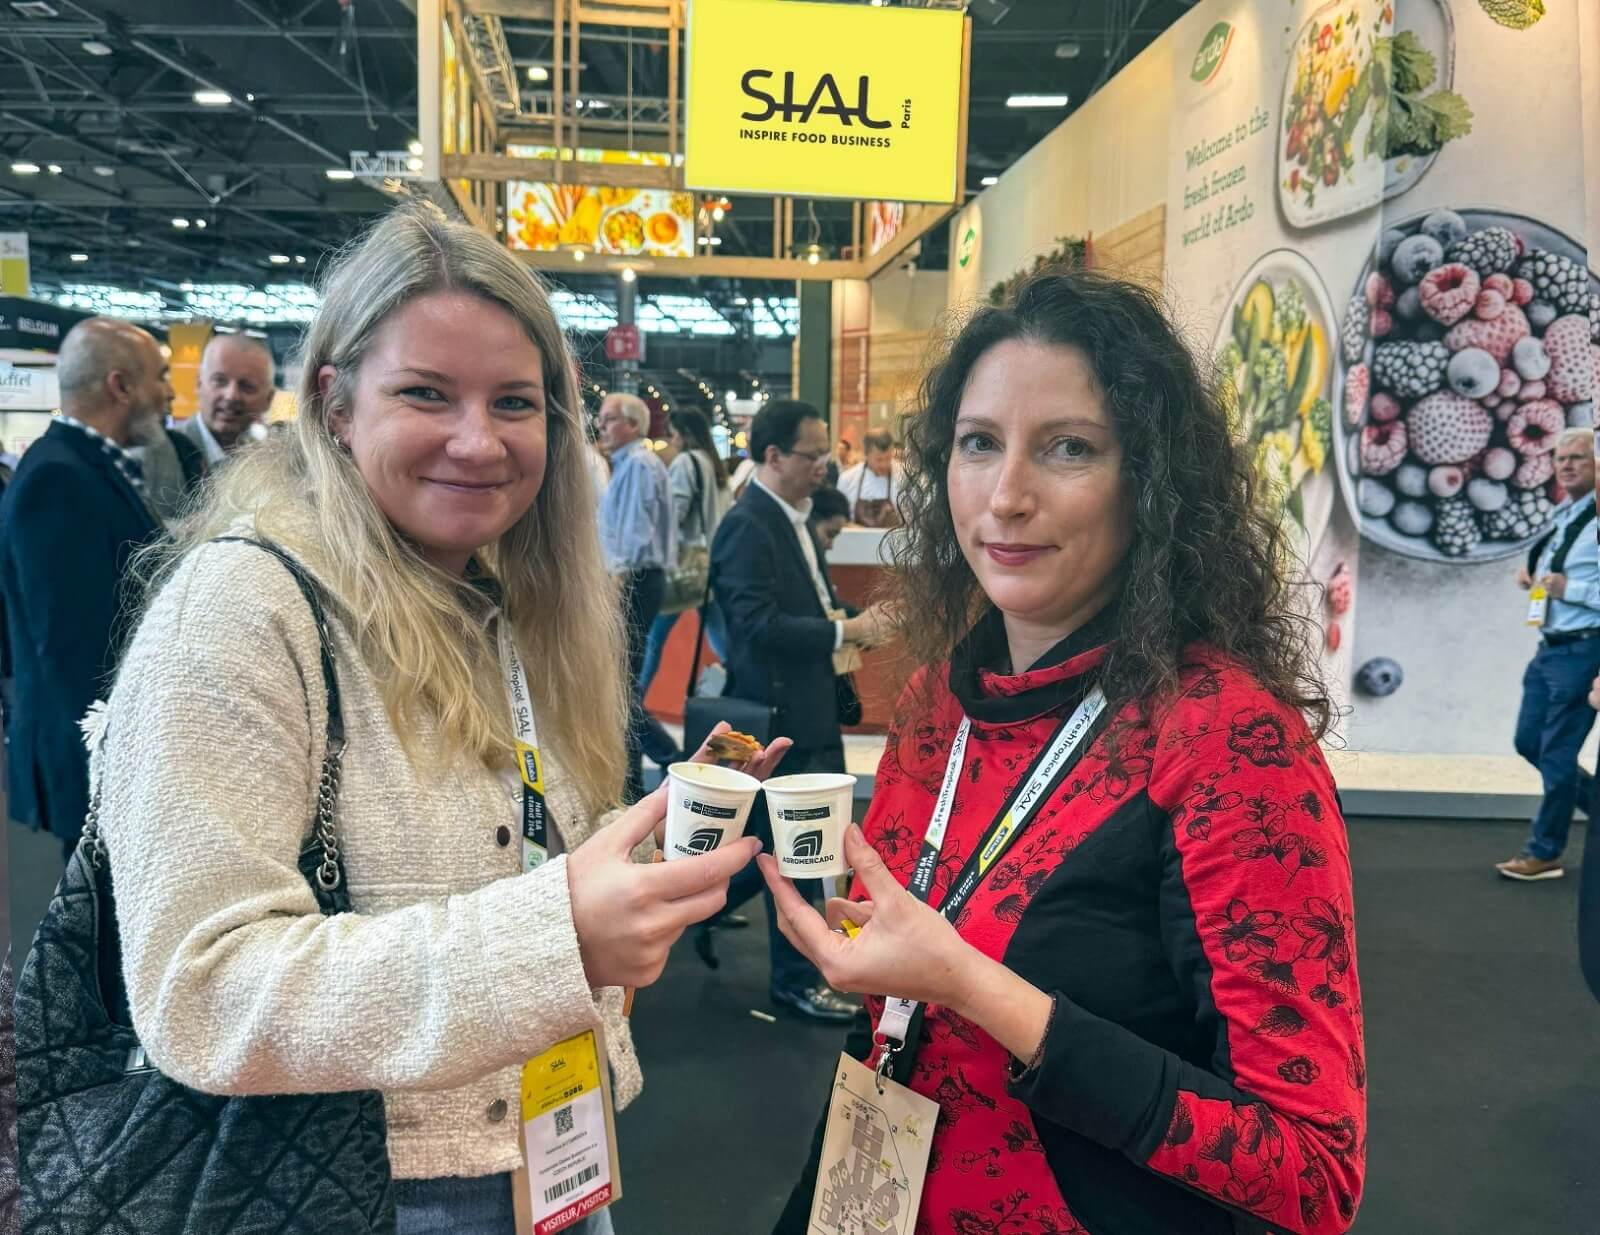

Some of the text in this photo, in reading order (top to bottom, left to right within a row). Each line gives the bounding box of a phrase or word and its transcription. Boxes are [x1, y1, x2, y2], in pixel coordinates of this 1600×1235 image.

[740, 69, 892, 129] SIAL
[901, 98, 912, 128] Paris
[739, 129, 891, 148] INSPIRE FOOD BUSINESS
[1185, 105, 1269, 171] Welcome to the
[1184, 166, 1246, 210] fresh frozen
[1183, 194, 1254, 247] world of Ardo
[17, 316, 59, 336] BELGIUM
[517, 706, 531, 738] SIAL
[1042, 713, 1091, 777] FreshTropical
[1020, 781, 1043, 811] SIAL
[782, 854, 834, 866] AGROMERCADO
[542, 1187, 610, 1232] VISITEUR/VISITOR
